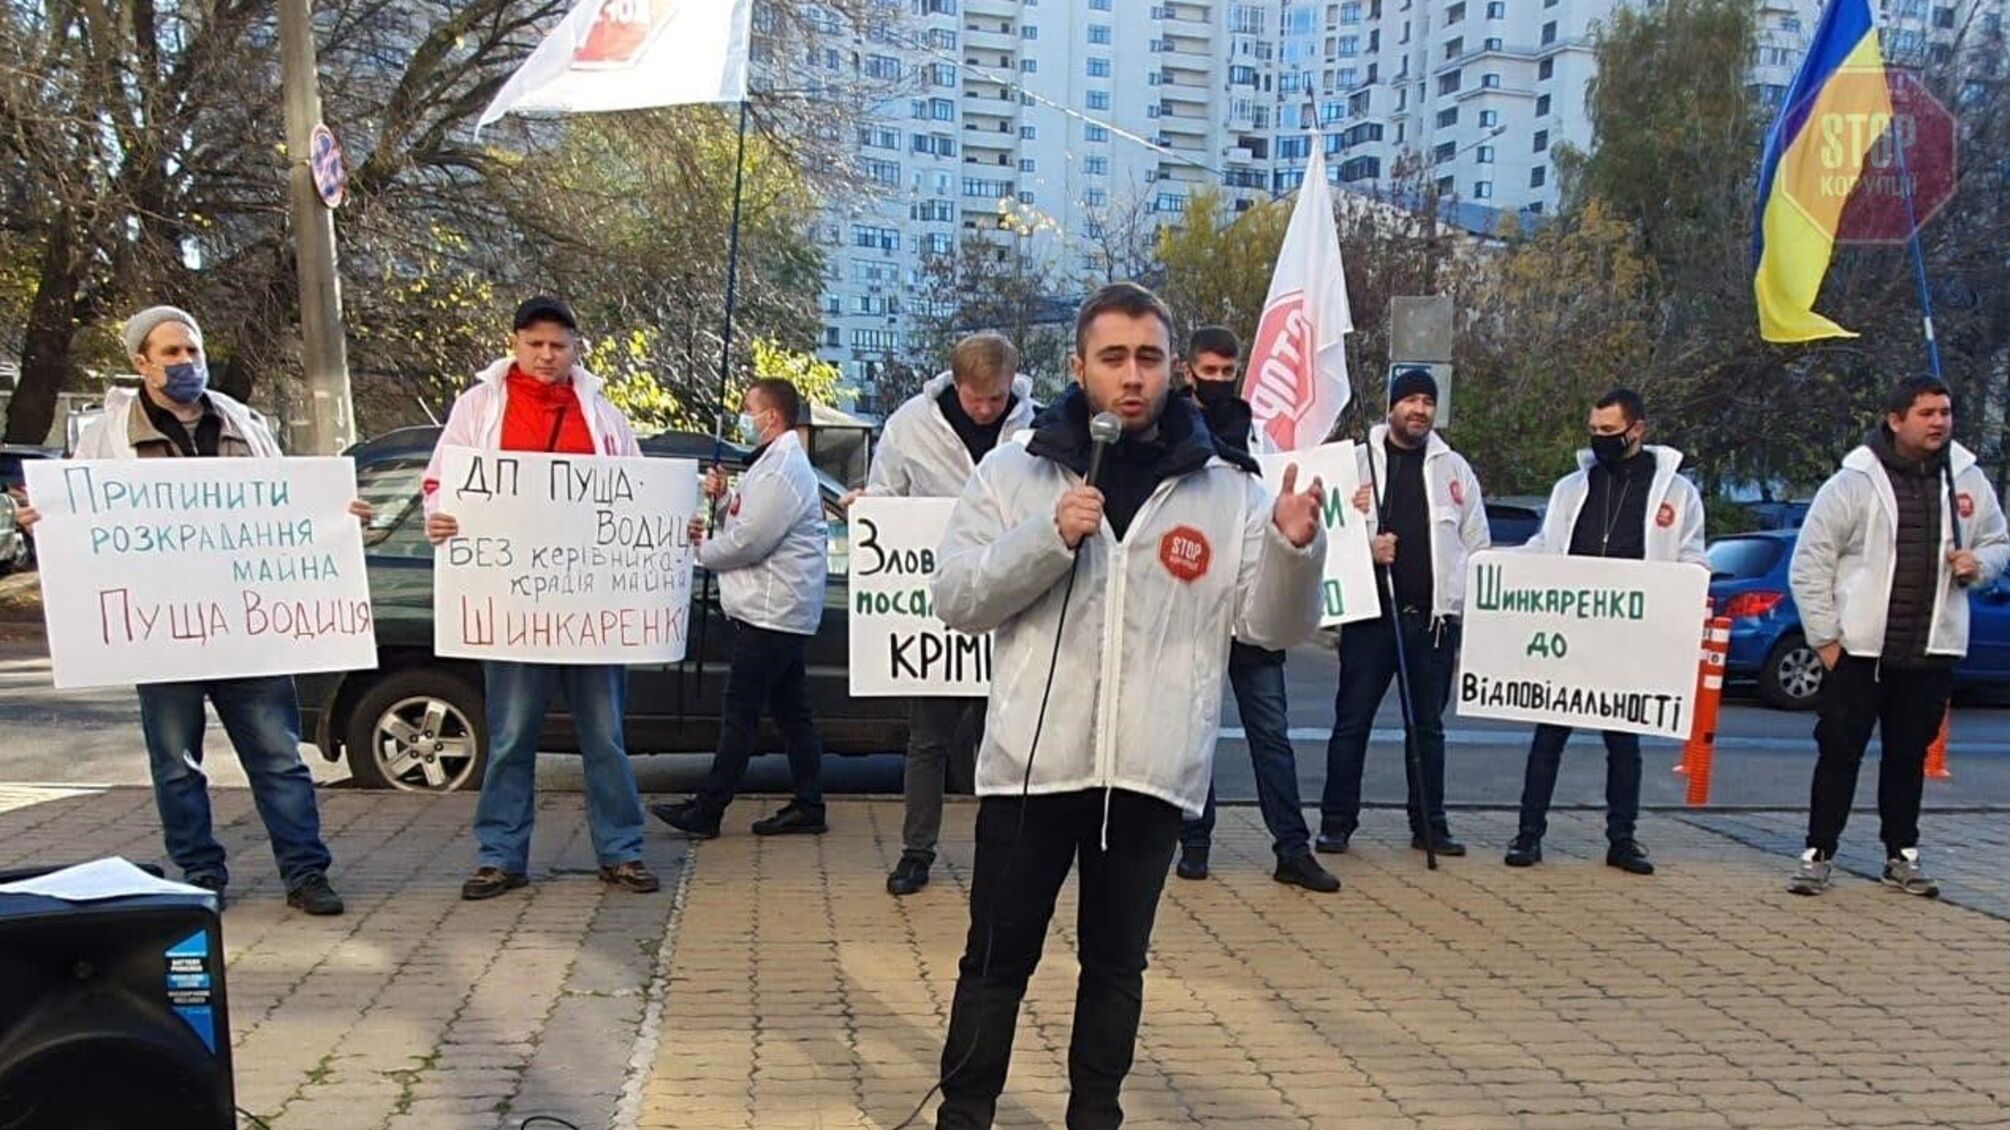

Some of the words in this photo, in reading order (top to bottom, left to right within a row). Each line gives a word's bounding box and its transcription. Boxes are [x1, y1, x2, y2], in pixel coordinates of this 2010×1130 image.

[456, 455, 518, 502] ДП
[90, 518, 314, 555] РОЗКРАДАННЯ
[449, 537, 514, 568] БЕЗ
[596, 509, 691, 556] ВОДИЦ
[857, 518, 936, 576] Злов
[1171, 535, 1203, 561] STOP
[232, 551, 339, 584] МАЙНА
[99, 587, 229, 647] ПУЩА
[856, 588, 934, 619] поса
[890, 626, 992, 683] КРІМІ
